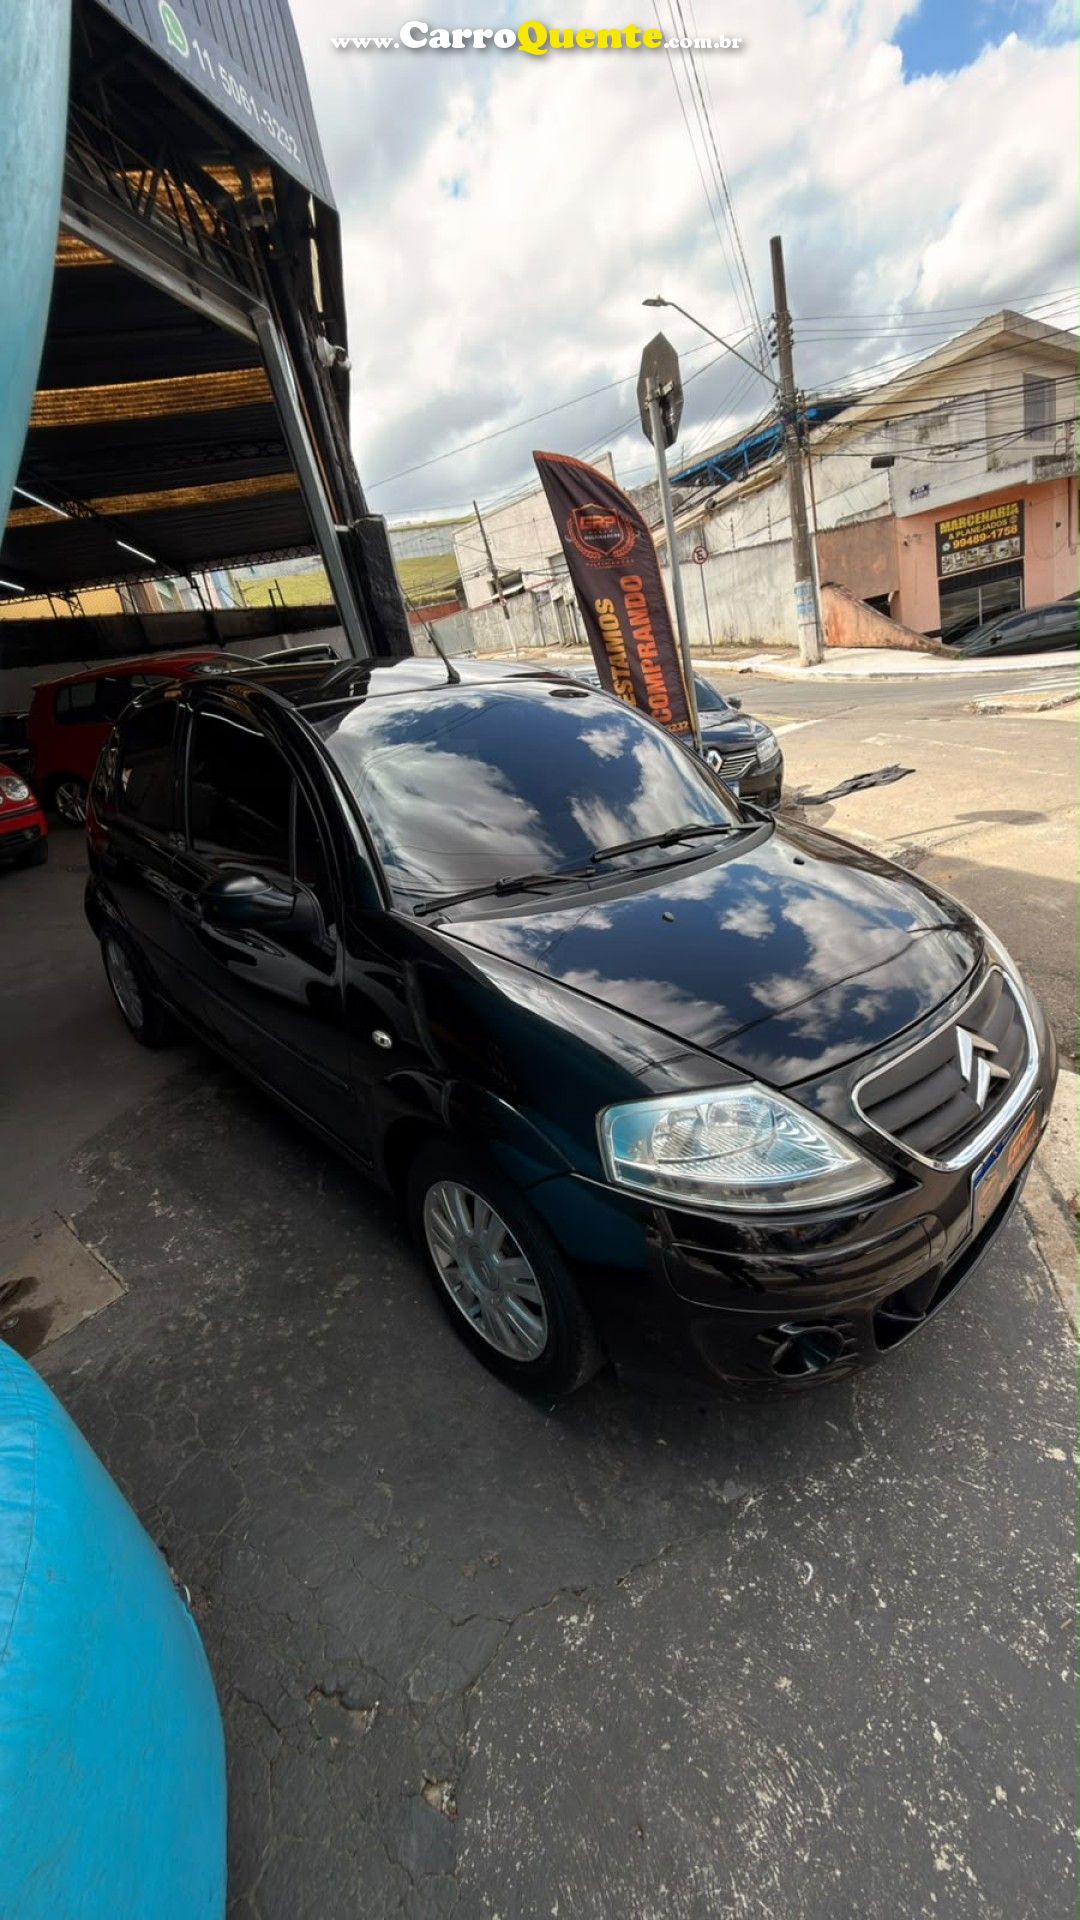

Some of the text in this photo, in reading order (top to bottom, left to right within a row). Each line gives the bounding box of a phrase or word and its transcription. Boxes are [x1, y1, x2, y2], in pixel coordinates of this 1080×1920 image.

[192, 39, 301, 163] 11 5061-3232
[940, 503, 1019, 534] MARCENARIA
[955, 520, 1008, 537] PLANEJADOS
[619, 574, 672, 723] COMPRANDO
